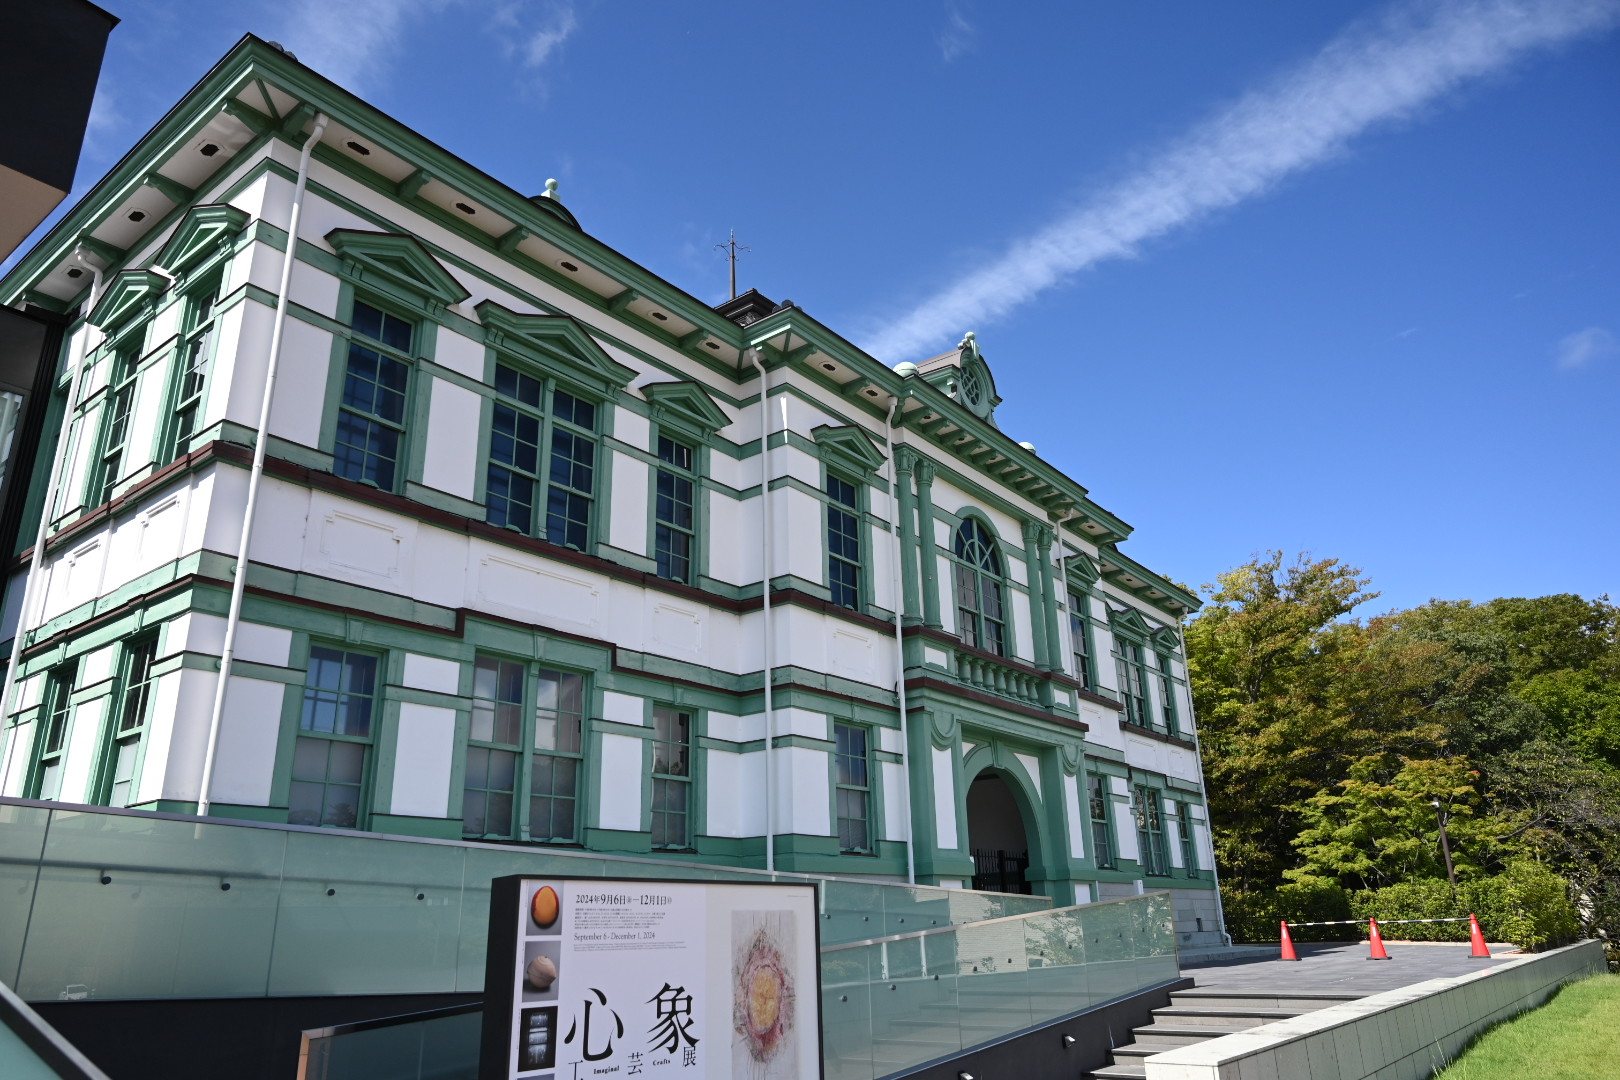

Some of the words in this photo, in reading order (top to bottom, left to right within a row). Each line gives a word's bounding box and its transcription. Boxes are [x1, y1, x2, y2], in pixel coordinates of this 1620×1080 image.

[573, 932, 602, 942] September
[603, 932, 607, 940] 6
[611, 931, 636, 940] December
[643, 930, 656, 940] 2024
[593, 1065, 620, 1075] Imaginal
[652, 1058, 671, 1067] Crafts
